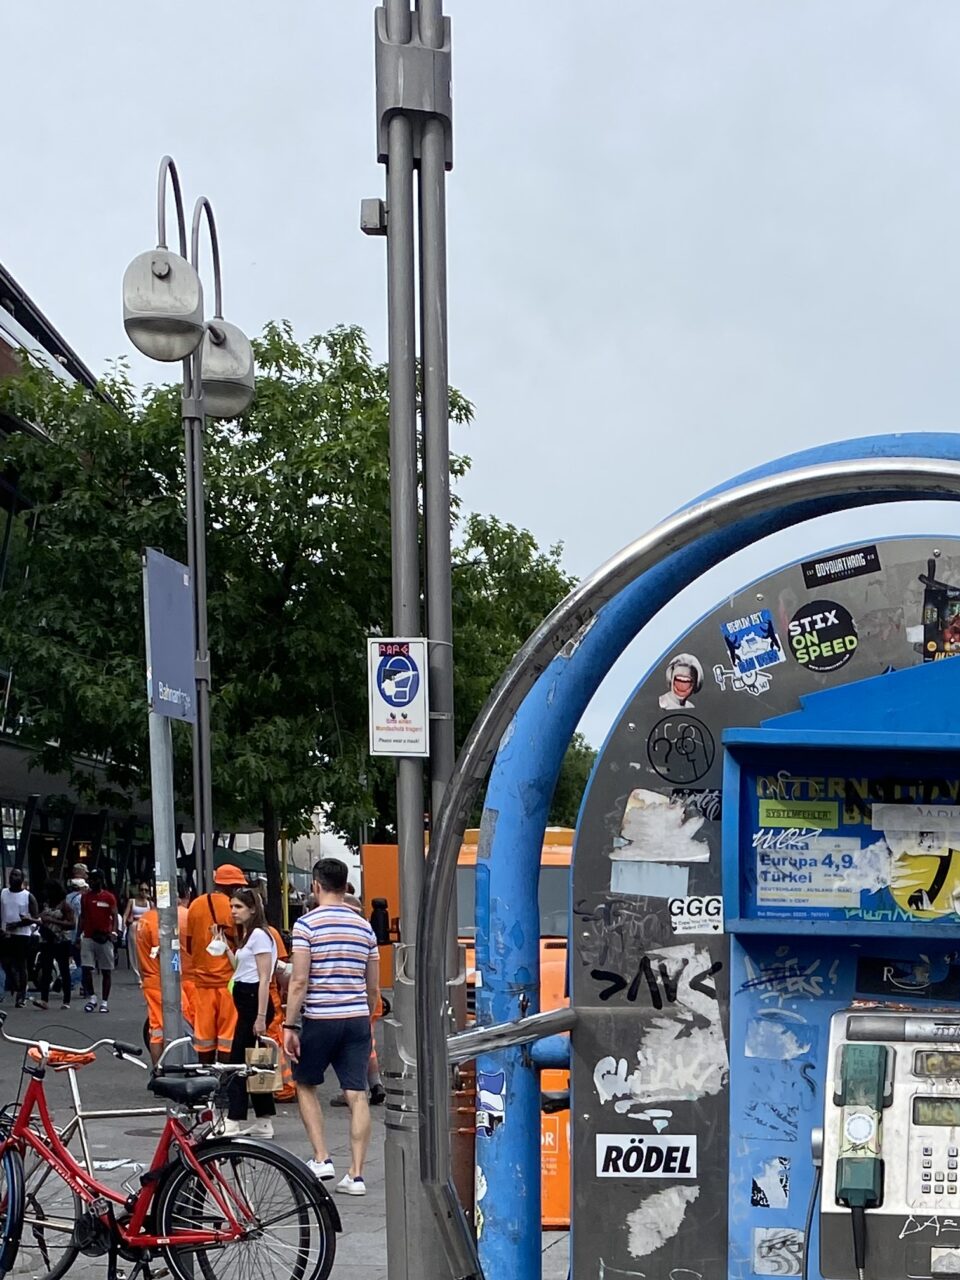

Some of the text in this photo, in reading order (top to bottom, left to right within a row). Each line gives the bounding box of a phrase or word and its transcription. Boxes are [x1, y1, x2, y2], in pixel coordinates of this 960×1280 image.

[788, 609, 840, 636] STIX
[792, 630, 819, 649] ON
[795, 634, 858, 664] SPEED
[760, 853, 818, 869] Europa
[760, 869, 813, 884] Türkei
[668, 897, 722, 917] GGG
[602, 1137, 692, 1174] RÖDEL
